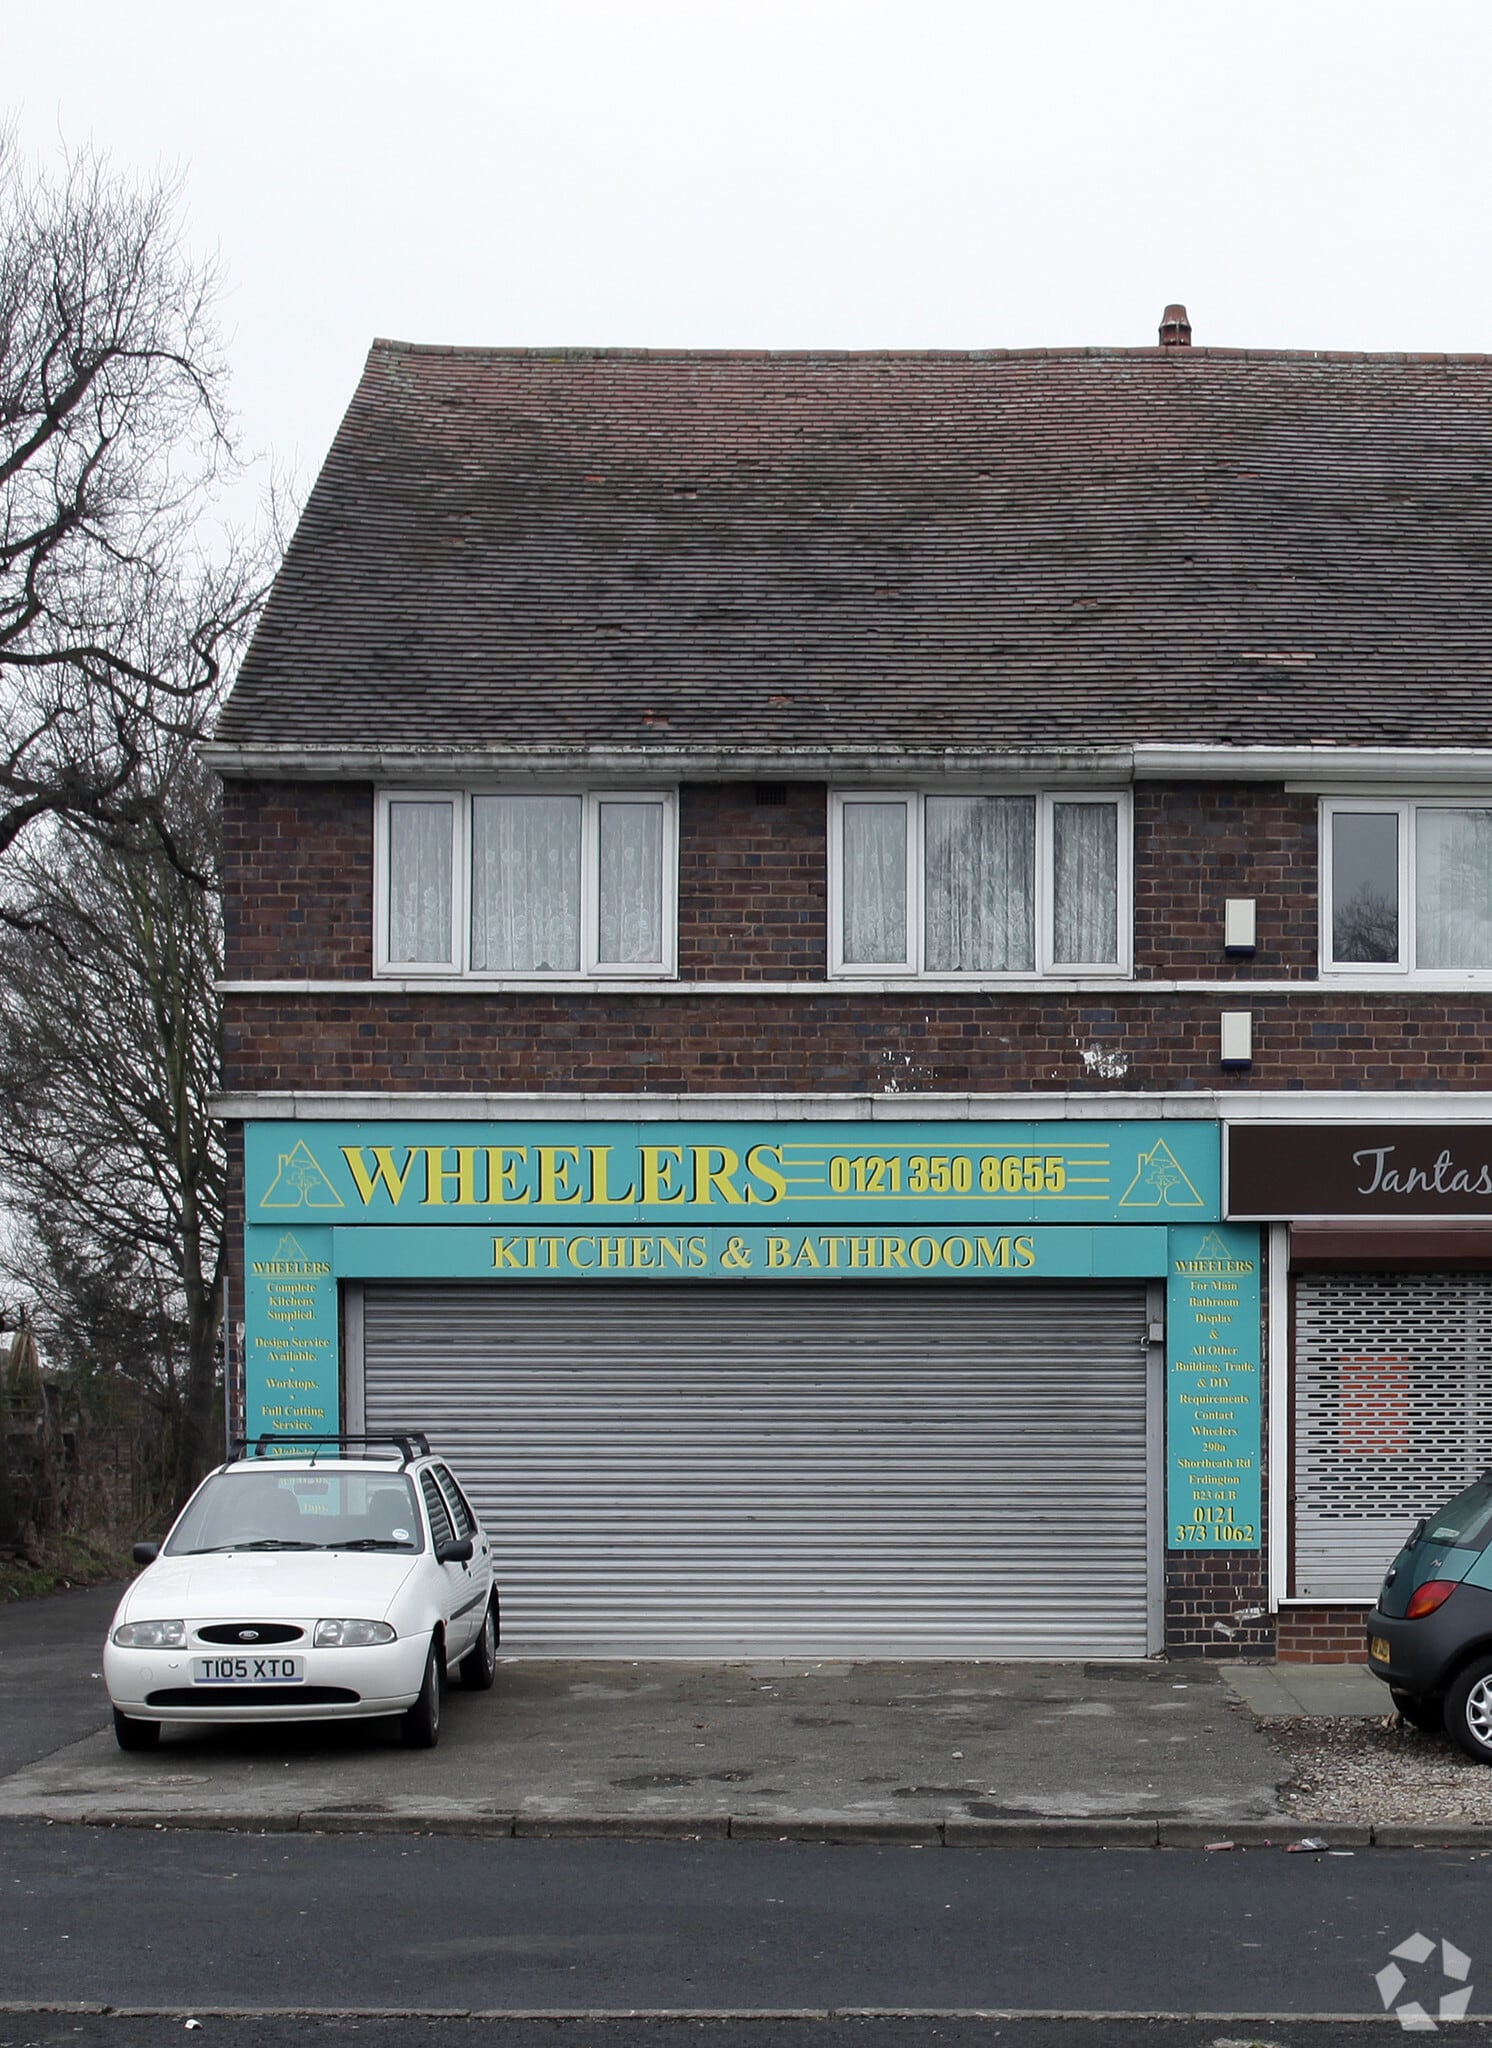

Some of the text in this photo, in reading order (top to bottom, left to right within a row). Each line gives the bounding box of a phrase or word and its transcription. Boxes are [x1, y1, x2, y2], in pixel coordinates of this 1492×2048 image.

[338, 1143, 787, 1206] WHEELERS
[829, 1156, 1066, 1192] 0121 350 8655
[490, 1235, 1036, 1270] KITCHENS & BATHROOMS
[252, 1262, 331, 1274] WHEELERS
[1174, 1260, 1254, 1273] WHEELERS
[267, 1282, 317, 1295] Complete
[1190, 1281, 1239, 1291] For Main
[269, 1296, 315, 1307] Kitchens
[1189, 1297, 1240, 1308] Bathroom
[1195, 1313, 1232, 1325] Display
[1209, 1329, 1220, 1340] &
[255, 1337, 330, 1349] Design Service
[1192, 1345, 1239, 1356] All Other
[1175, 1361, 1221, 1373] Building,
[266, 1378, 319, 1391] Worktops.
[1197, 1377, 1232, 1388] & DIY
[1180, 1393, 1250, 1406] Requirements
[261, 1406, 325, 1418] Full Cutting
[1194, 1410, 1235, 1420] Contact
[1191, 1425, 1239, 1437] Wheelers
[1177, 1457, 1252, 1469] Shortheath Rd
[1189, 1473, 1241, 1486] Erdington
[1193, 1490, 1237, 1501] B23 6LB
[1193, 1505, 1236, 1524] 0121
[1175, 1524, 1255, 1543] 373 1062
[253, 1659, 296, 1677] XTO
